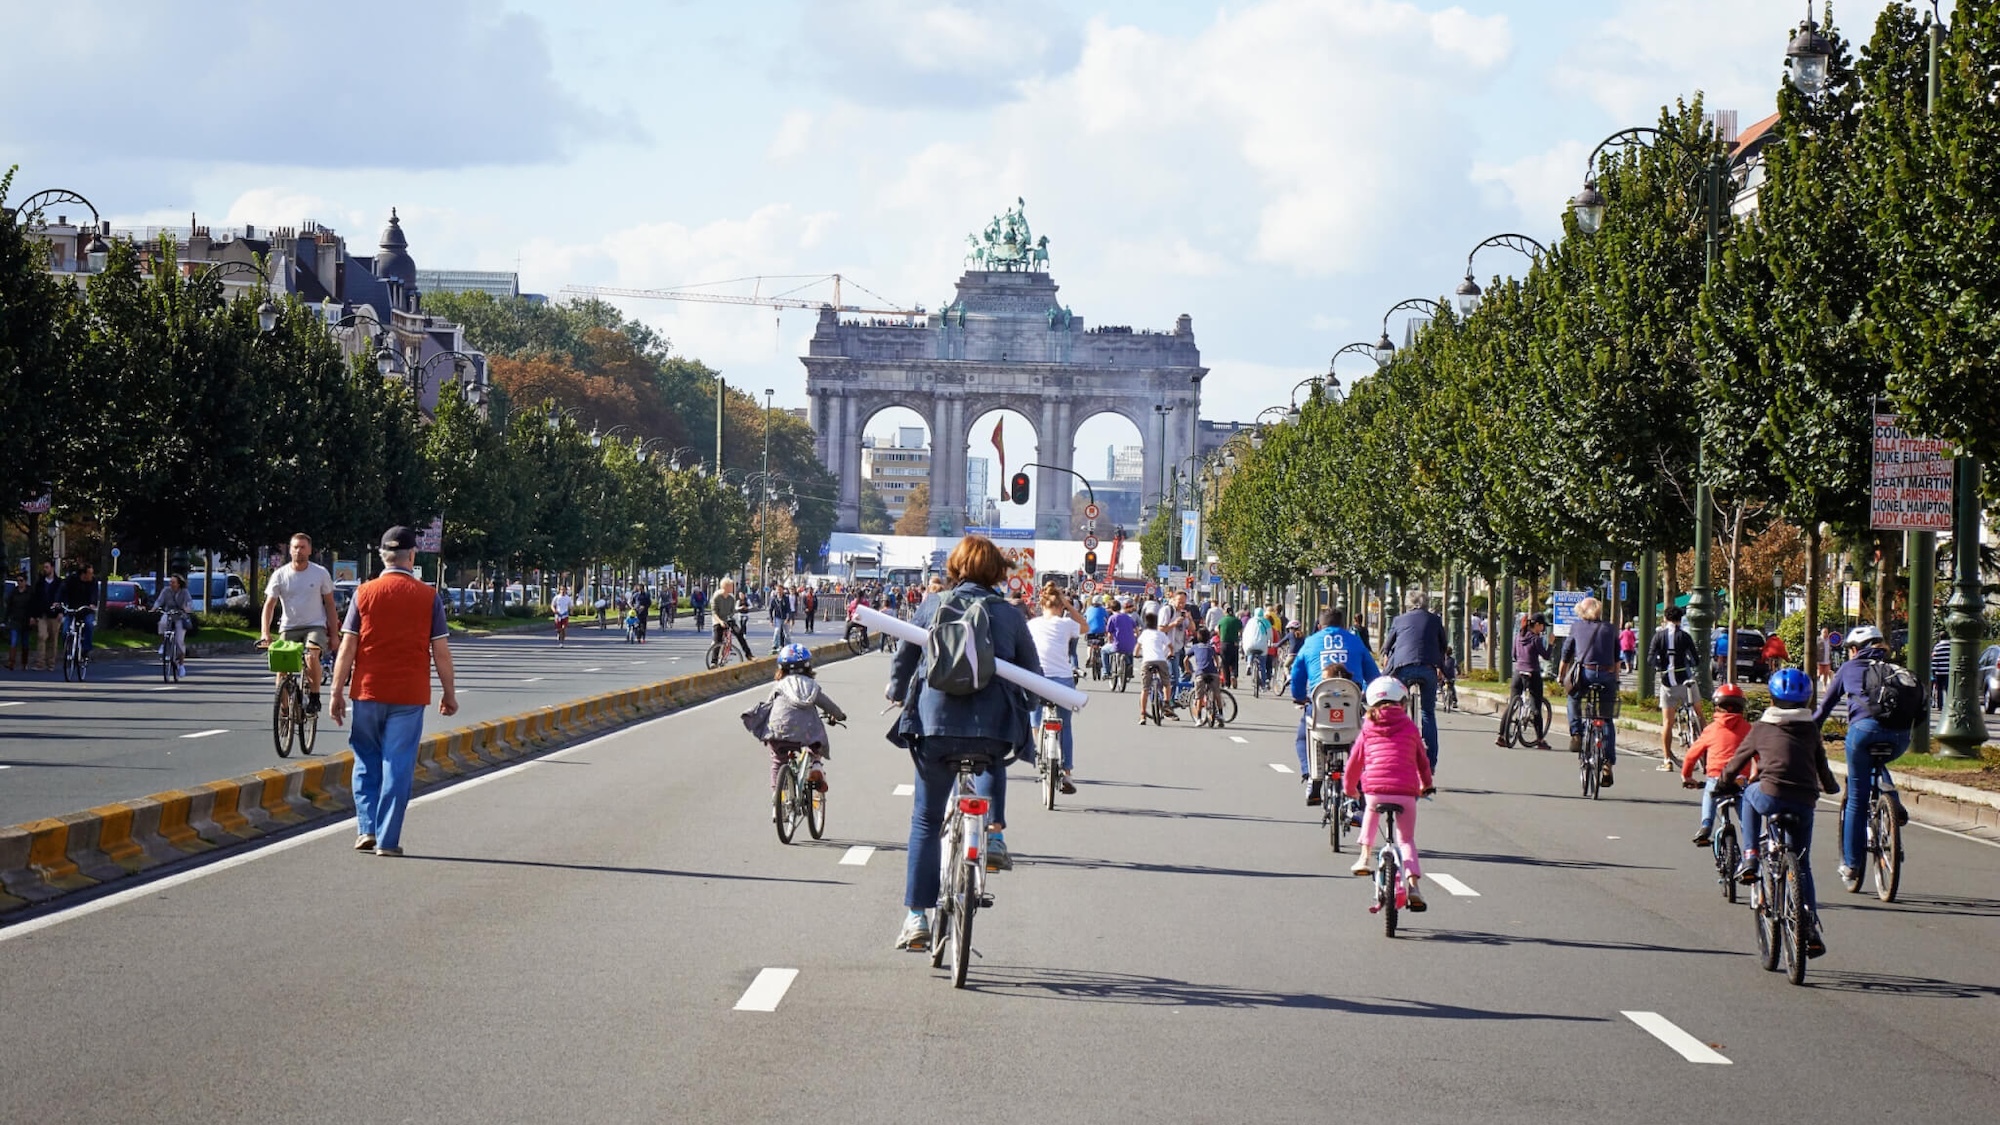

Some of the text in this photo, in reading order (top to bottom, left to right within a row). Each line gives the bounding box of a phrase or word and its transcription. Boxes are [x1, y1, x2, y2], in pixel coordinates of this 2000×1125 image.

[1875, 427, 1910, 439] COUN
[1875, 439, 1897, 451] ELLA
[1874, 451, 1946, 463] DUKE ELLINGT
[1874, 477, 1952, 489] DEAN MARTIN
[1873, 487, 1952, 501] LOUIS ARMSTRONG
[1873, 500, 1951, 514] LIONEL HAMPTON
[1872, 512, 1951, 526] JUDY GARLAND
[1323, 634, 1344, 650] 03
